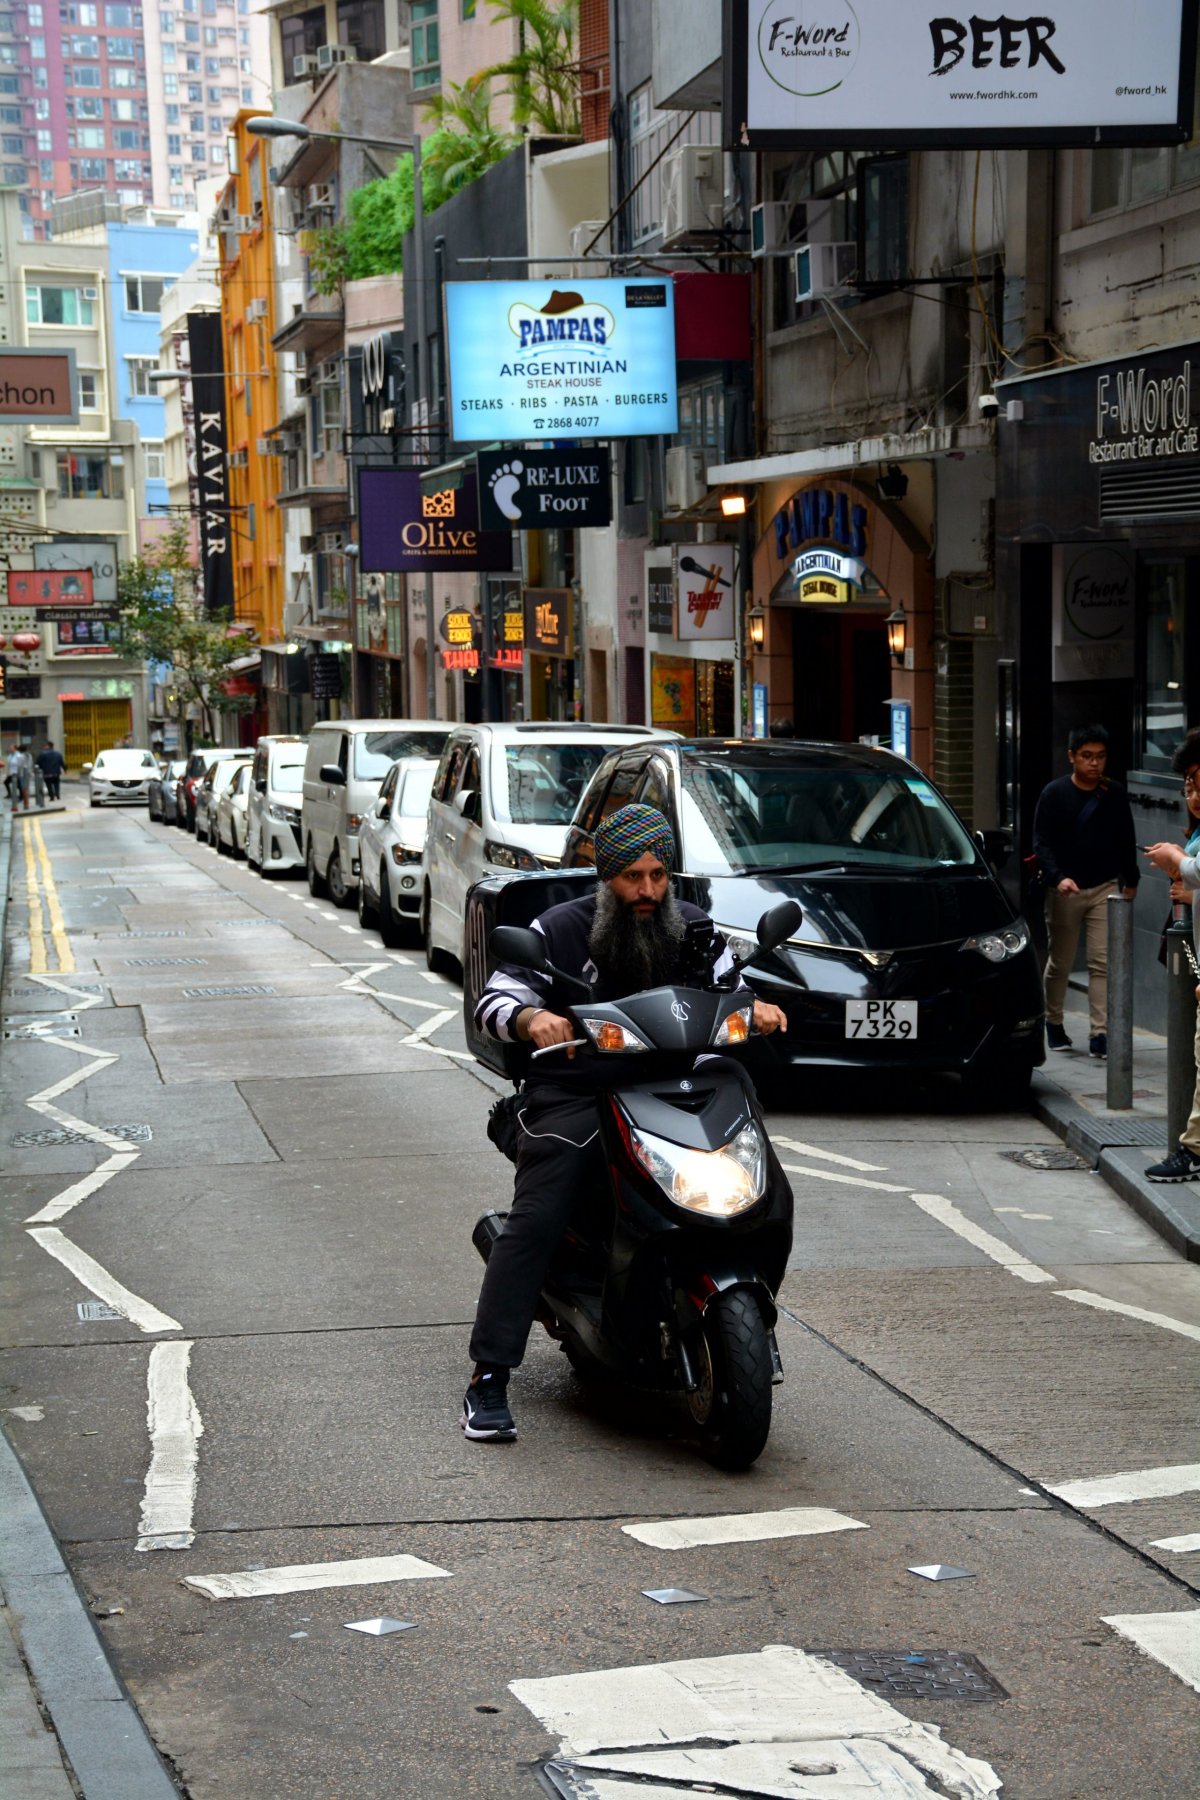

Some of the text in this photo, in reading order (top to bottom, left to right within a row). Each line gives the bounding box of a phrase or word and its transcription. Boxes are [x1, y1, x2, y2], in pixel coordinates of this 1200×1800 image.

[768, 16, 850, 51] F-Word
[781, 46, 826, 57] Restaurant
[835, 47, 852, 57] Bar
[928, 14, 1066, 77] BEER
[950, 90, 1038, 100] www.fwordhk.com
[1115, 85, 1167, 96] @fword_hk
[519, 316, 607, 348] PAMPAS
[499, 360, 628, 377] ARGENTINIAN
[0, 381, 55, 405] hon
[526, 378, 602, 389] STEAK HOUSE
[460, 393, 669, 411] STEAKS RIBS PASTA BURGERS
[1097, 360, 1191, 439] F-Word
[547, 416, 600, 429] 2868 4077
[1089, 437, 1138, 464] Restaurant
[1138, 434, 1155, 458] Bar
[1155, 430, 1175, 456] and
[200, 411, 227, 557] KAVIAR
[526, 465, 600, 486] RE-LUXE
[401, 520, 477, 548] Olive
[774, 489, 868, 560] PAMPAS
[442, 649, 480, 670] THAI
[866, 1001, 897, 1020] PK
[850, 1019, 913, 1039] 7329
